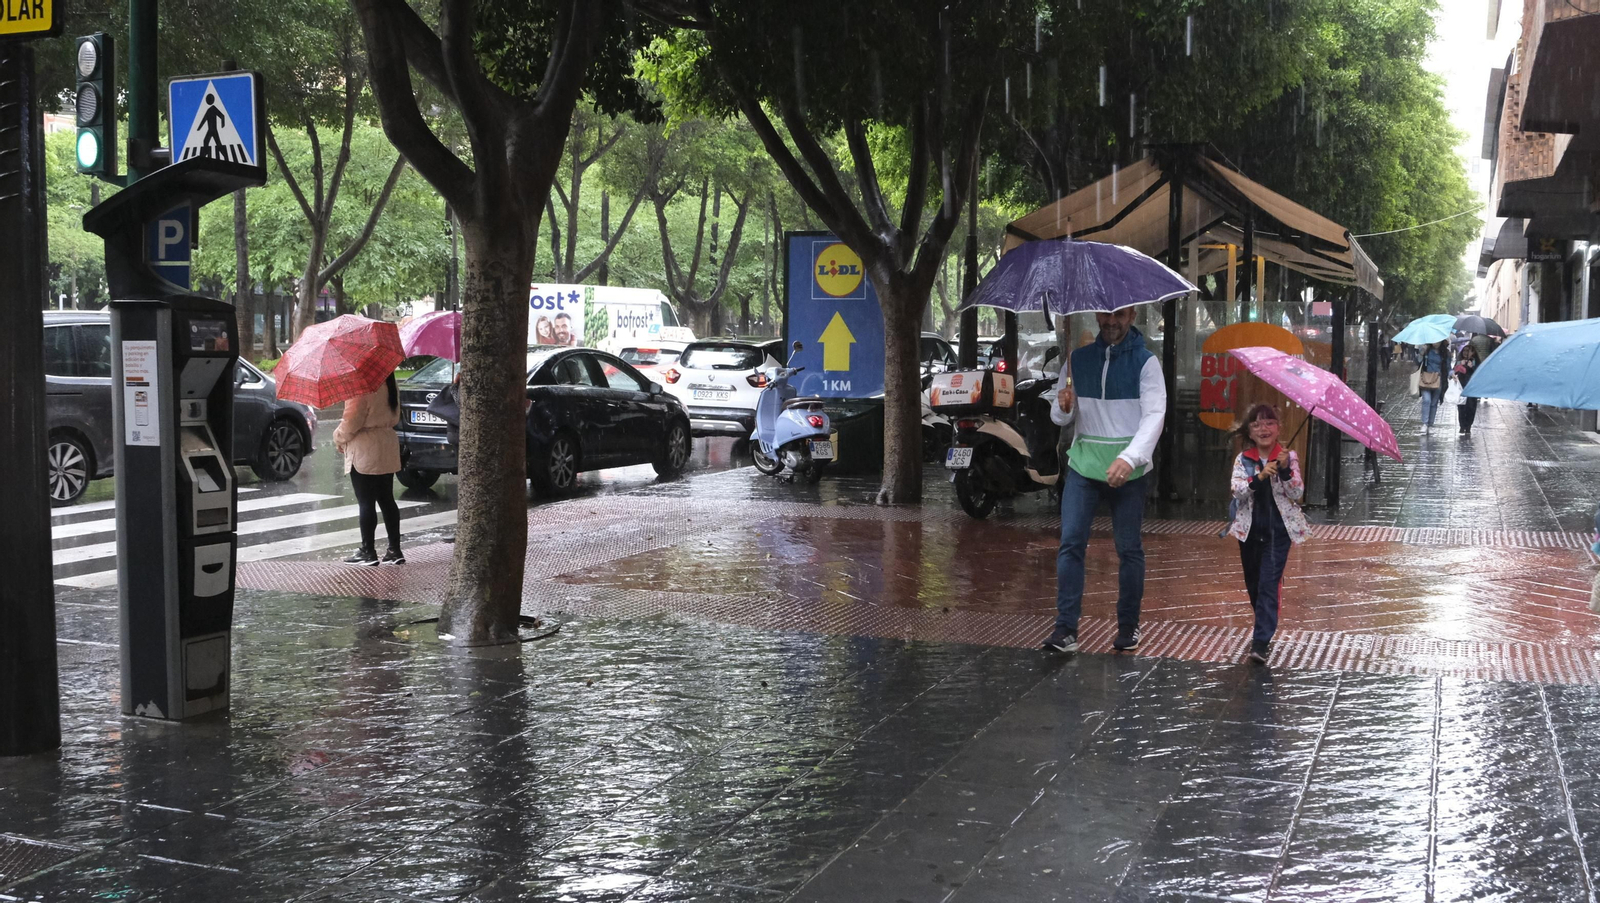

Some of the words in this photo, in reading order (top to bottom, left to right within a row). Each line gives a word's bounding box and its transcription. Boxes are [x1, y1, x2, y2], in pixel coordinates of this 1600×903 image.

[158, 220, 184, 259] P
[1531, 251, 1562, 261] hogarium
[823, 380, 829, 391] 1
[831, 380, 852, 391] KM
[697, 390, 713, 398] 0923
[953, 449, 971, 457] 2460
